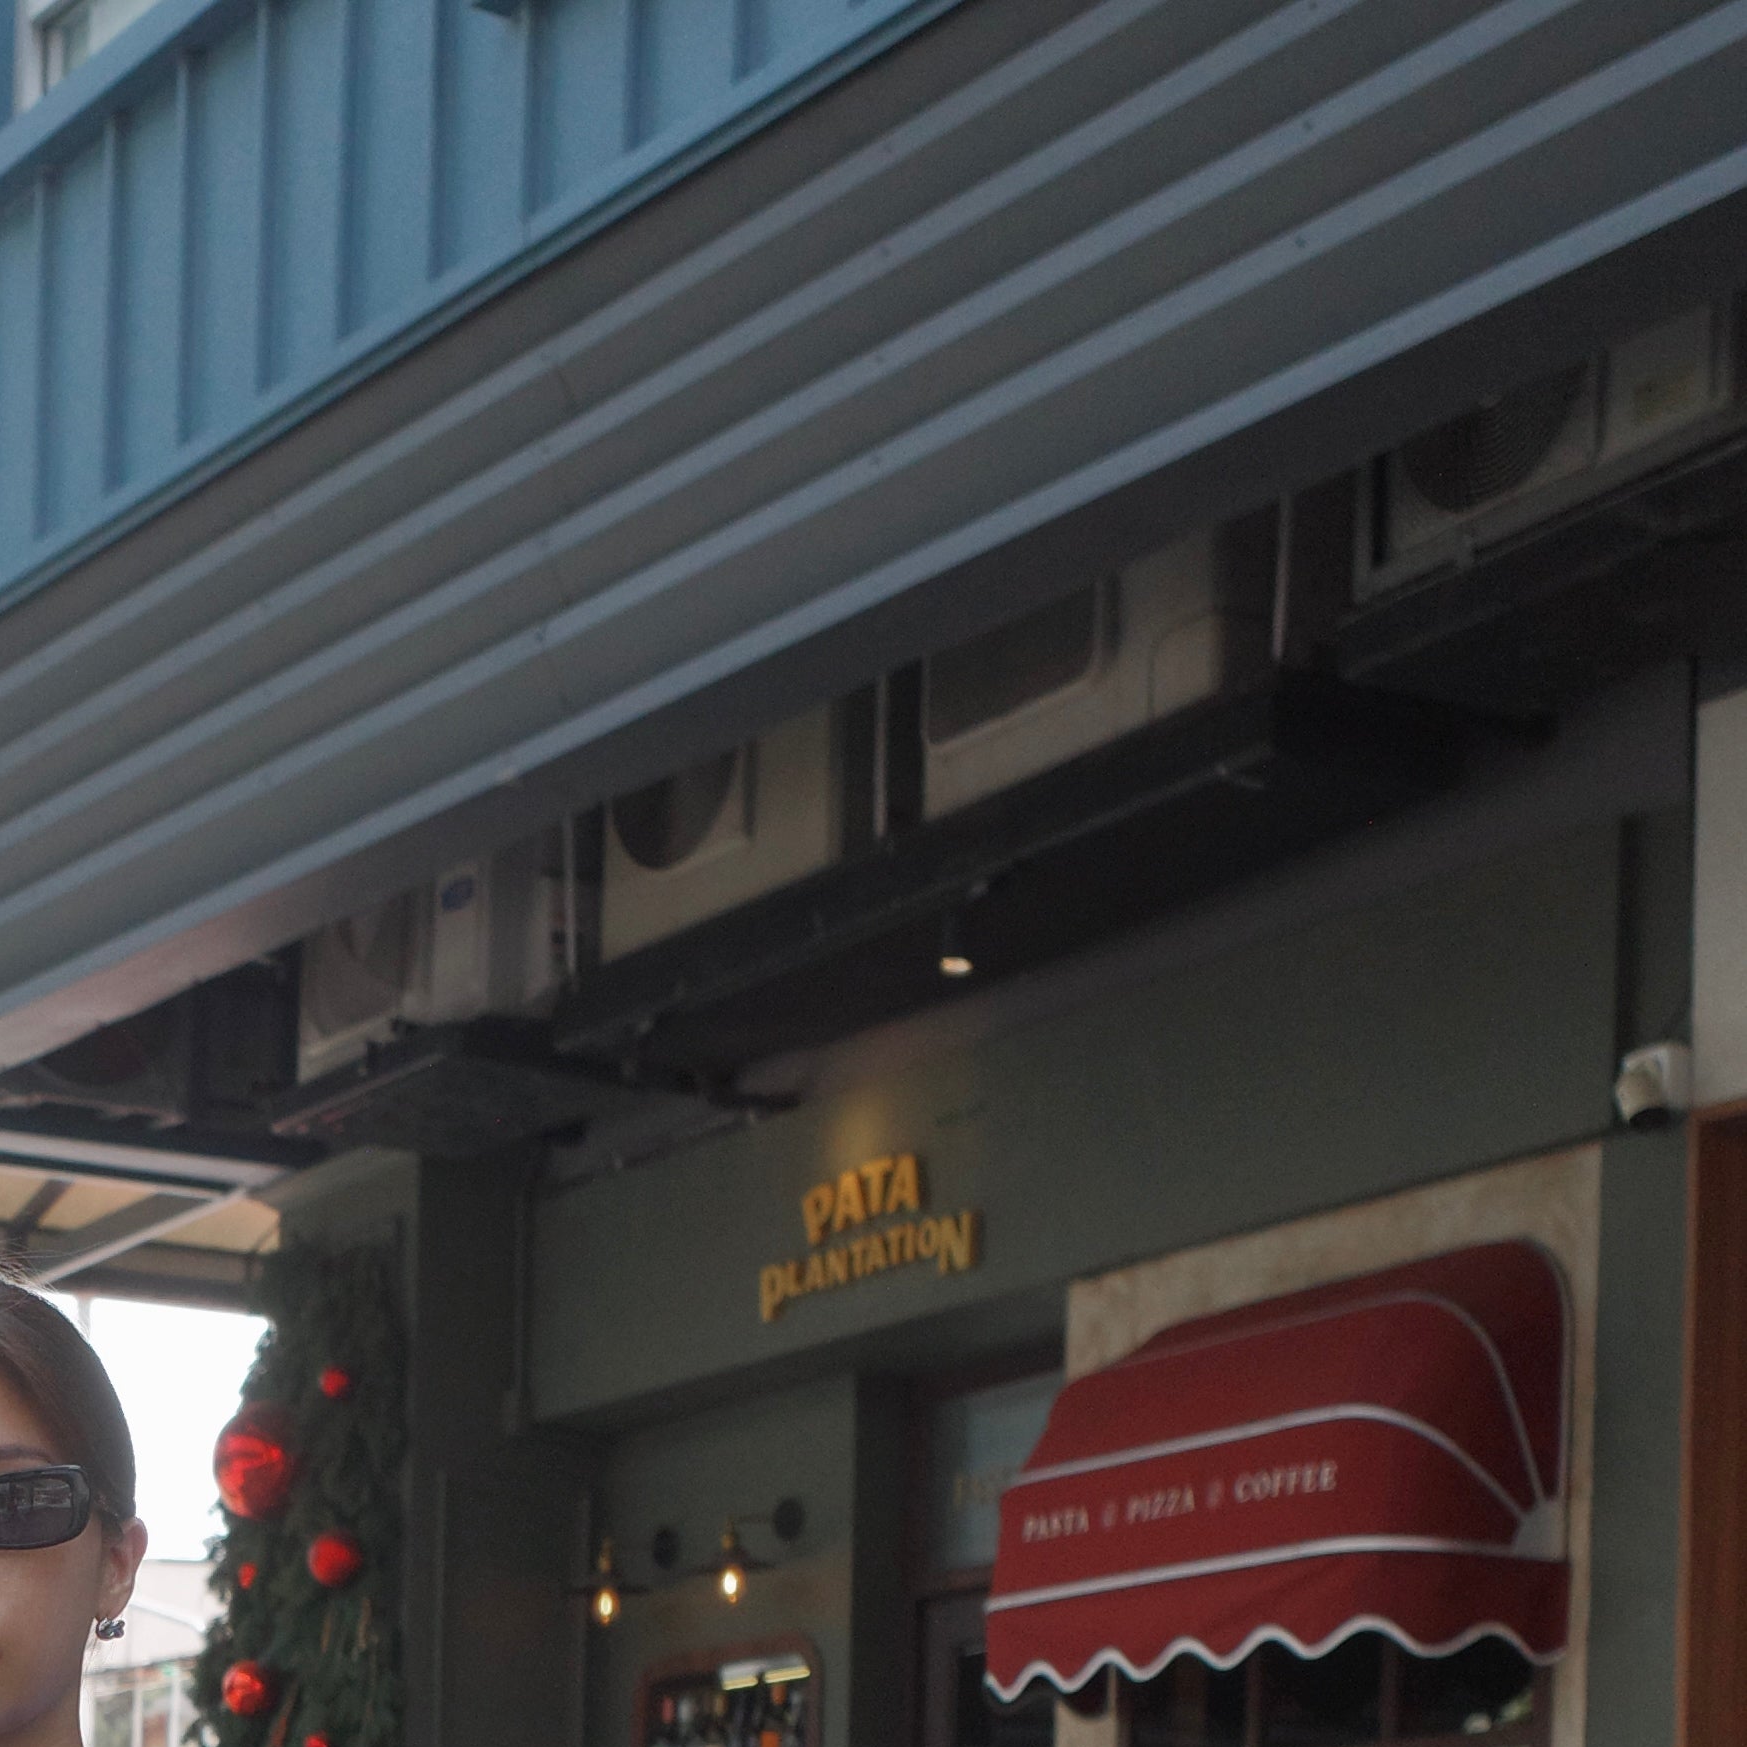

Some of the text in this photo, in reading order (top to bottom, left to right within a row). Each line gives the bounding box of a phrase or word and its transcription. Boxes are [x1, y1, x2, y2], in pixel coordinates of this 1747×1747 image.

[802, 1154, 920, 1245] PATA
[758, 1209, 976, 1323] PLANTATION
[1021, 1504, 1090, 1543] PASTA
[1127, 1485, 1195, 1525] PIZZA
[1234, 1458, 1338, 1504] COFFEE
